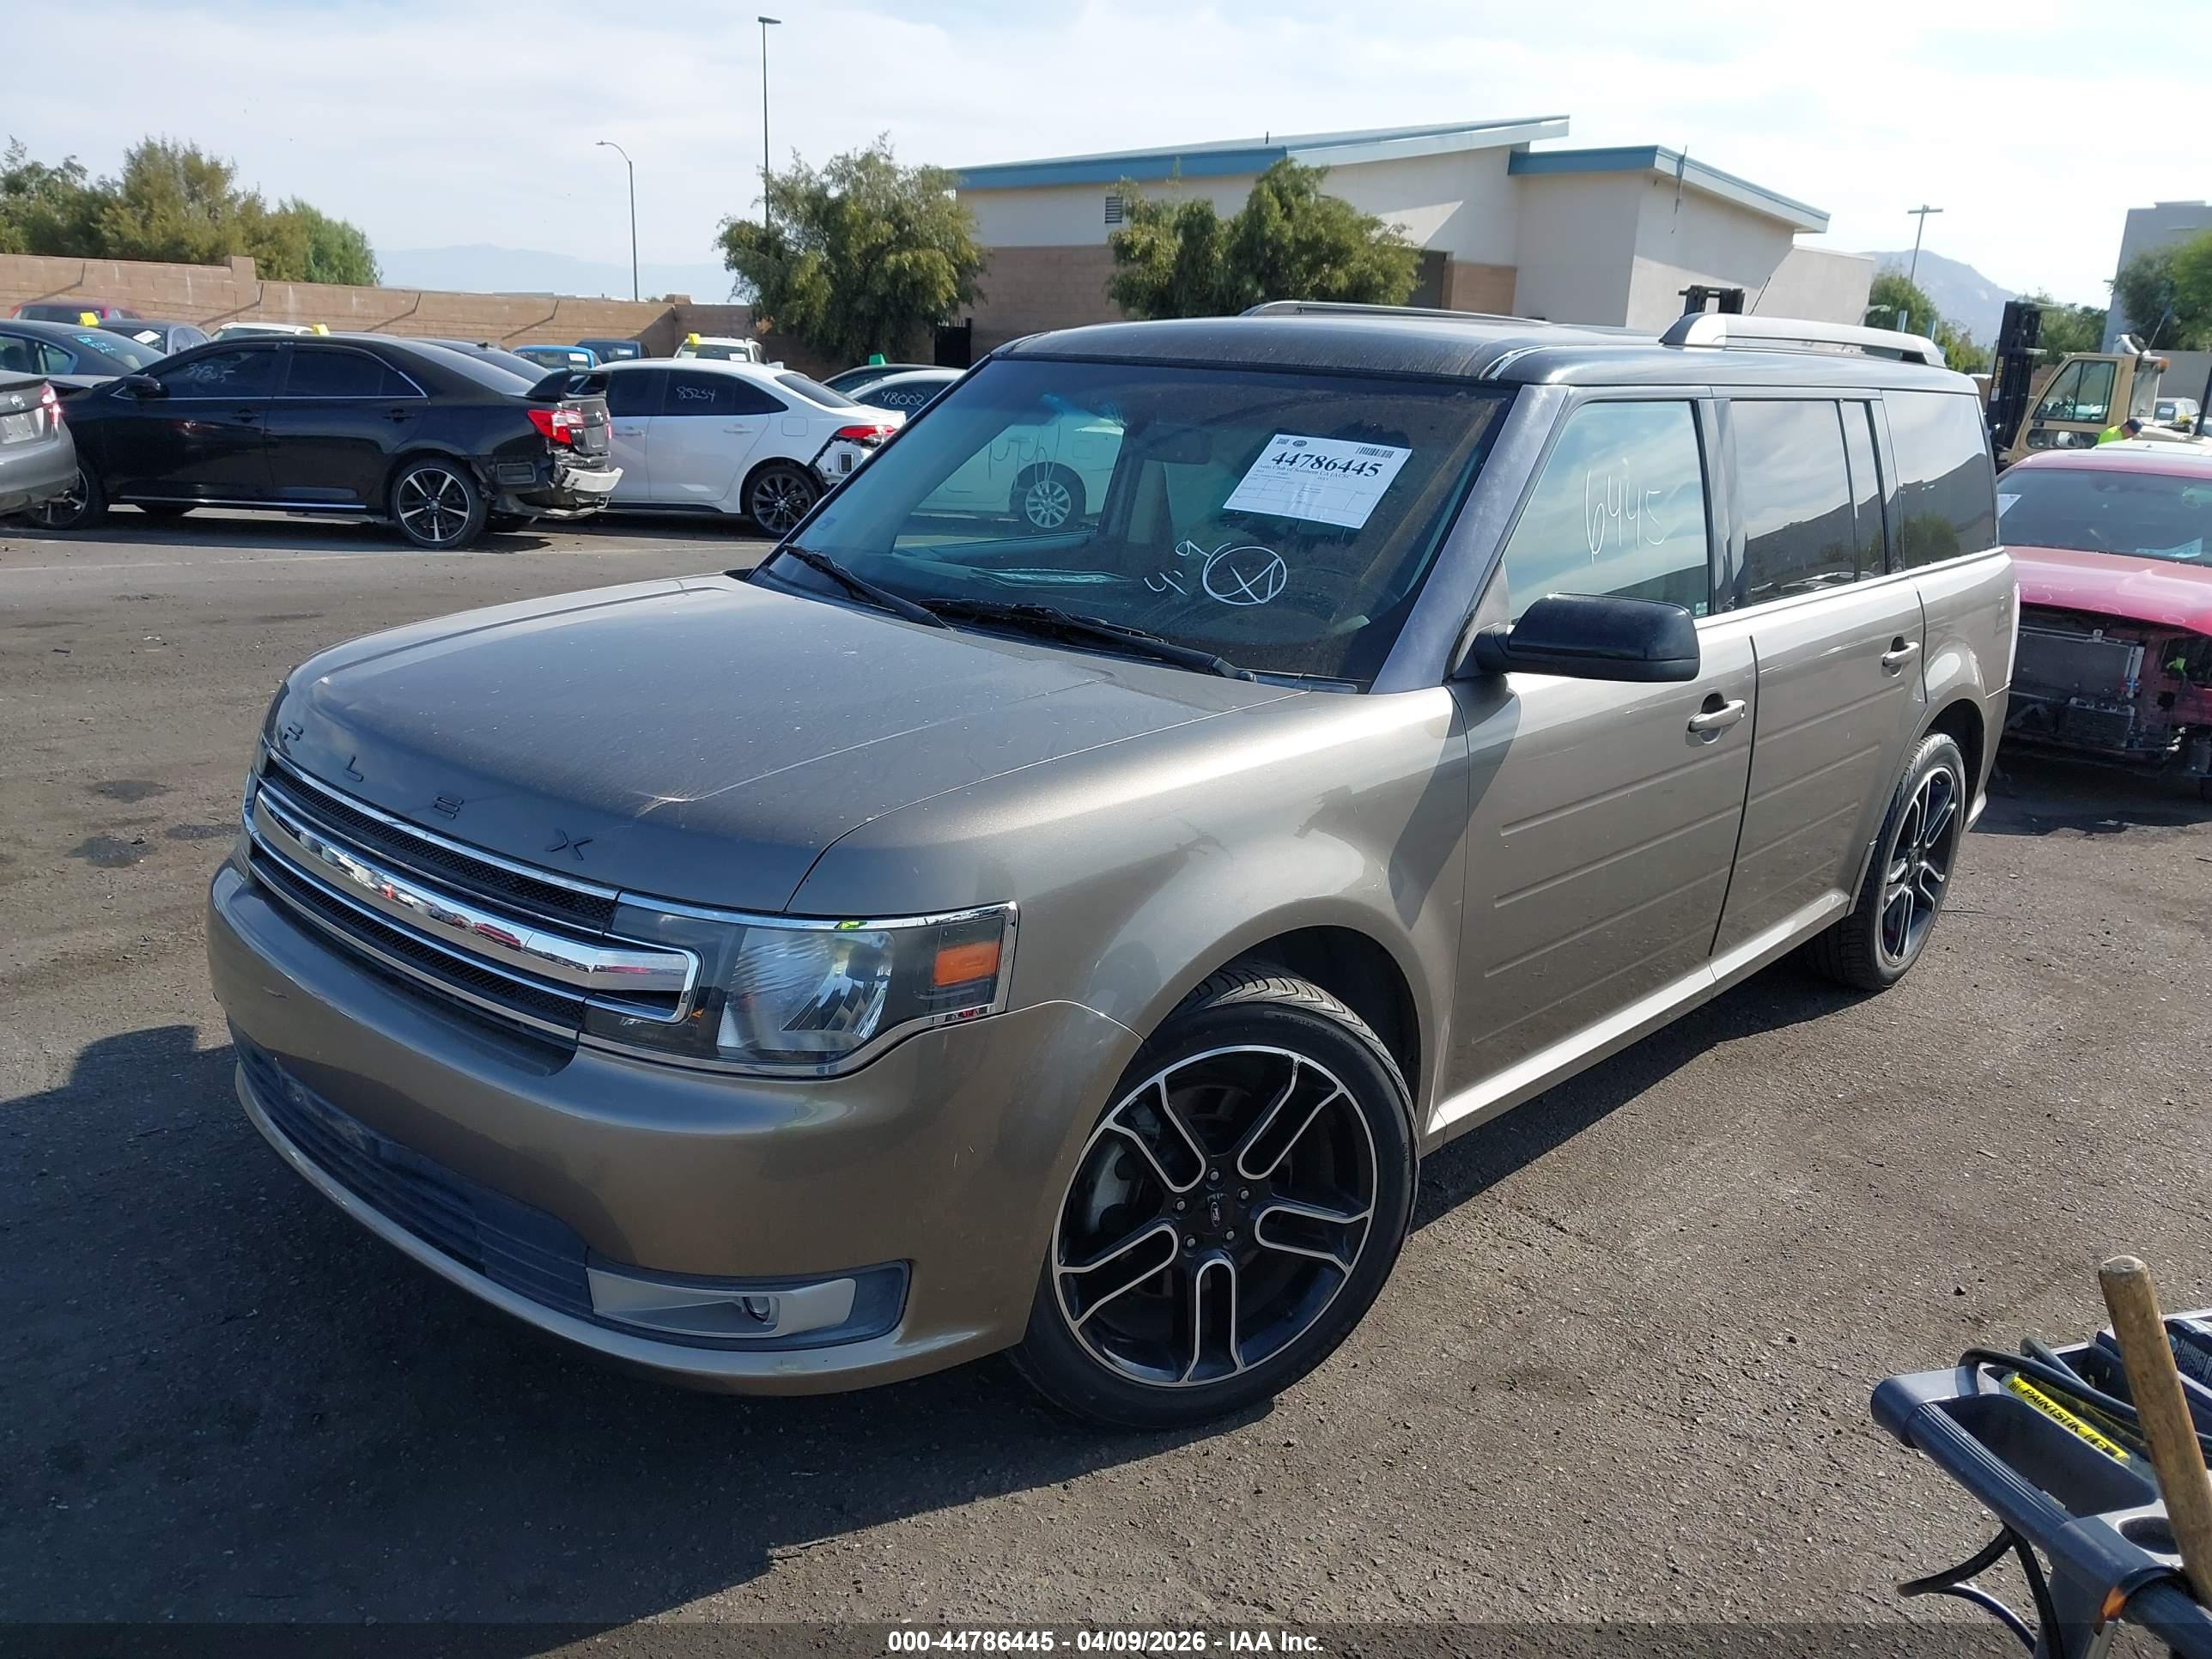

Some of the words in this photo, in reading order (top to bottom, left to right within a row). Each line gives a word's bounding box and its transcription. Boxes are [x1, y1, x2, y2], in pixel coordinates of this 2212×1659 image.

[881, 391, 925, 407] 48002
[1271, 451, 1383, 477] 44786445
[1585, 470, 1667, 565] 6445
[2021, 1389, 2085, 1434] PAINTSTIK
